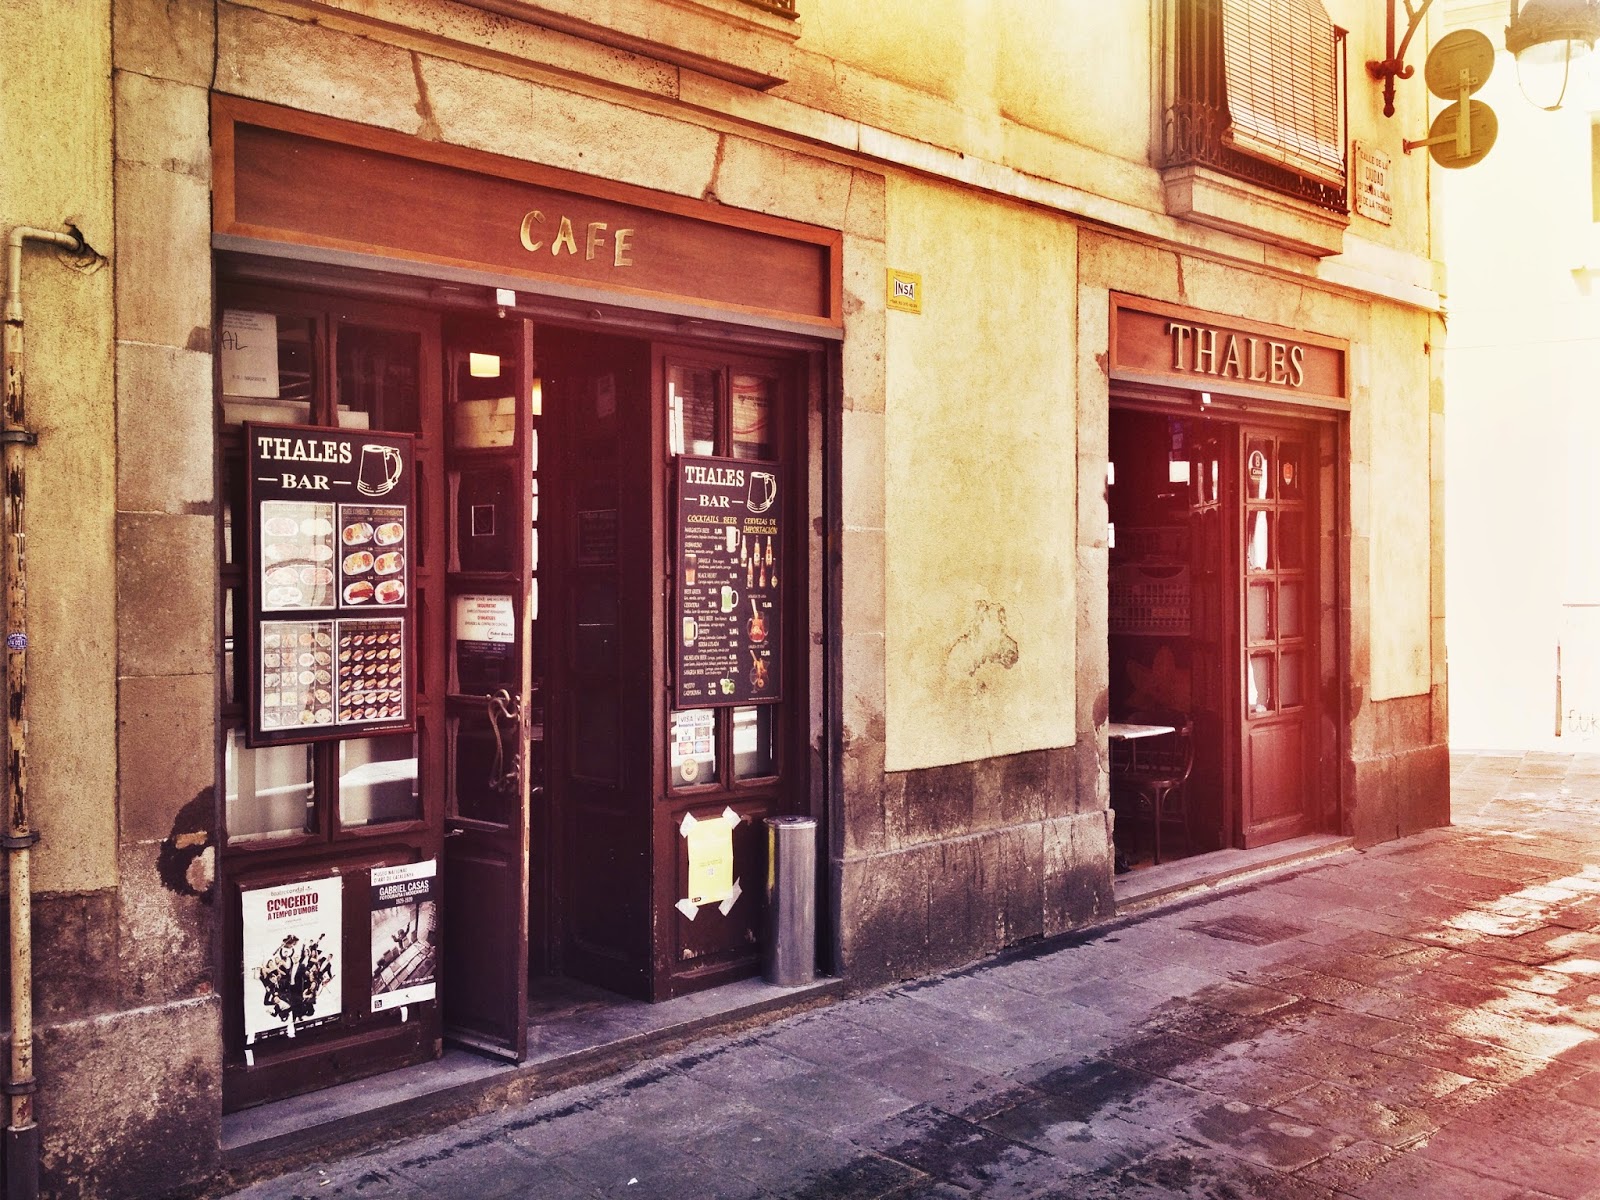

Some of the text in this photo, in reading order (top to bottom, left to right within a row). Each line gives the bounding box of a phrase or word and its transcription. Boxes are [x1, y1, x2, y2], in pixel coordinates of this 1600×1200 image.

[1376, 158, 1381, 168] DE
[520, 210, 634, 266] CAFE
[896, 280, 913, 298] INSA
[1170, 322, 1304, 387] THALES
[258, 436, 352, 464] THALES
[281, 473, 330, 490] BAR
[685, 466, 744, 487] THALES
[700, 494, 730, 507] BAR
[687, 515, 718, 523] COCKTAILS
[379, 880, 429, 896] GABRIEL CASAS
[267, 892, 318, 912] CONCERTO
[268, 905, 318, 921] A TEMPO D'UMORE
